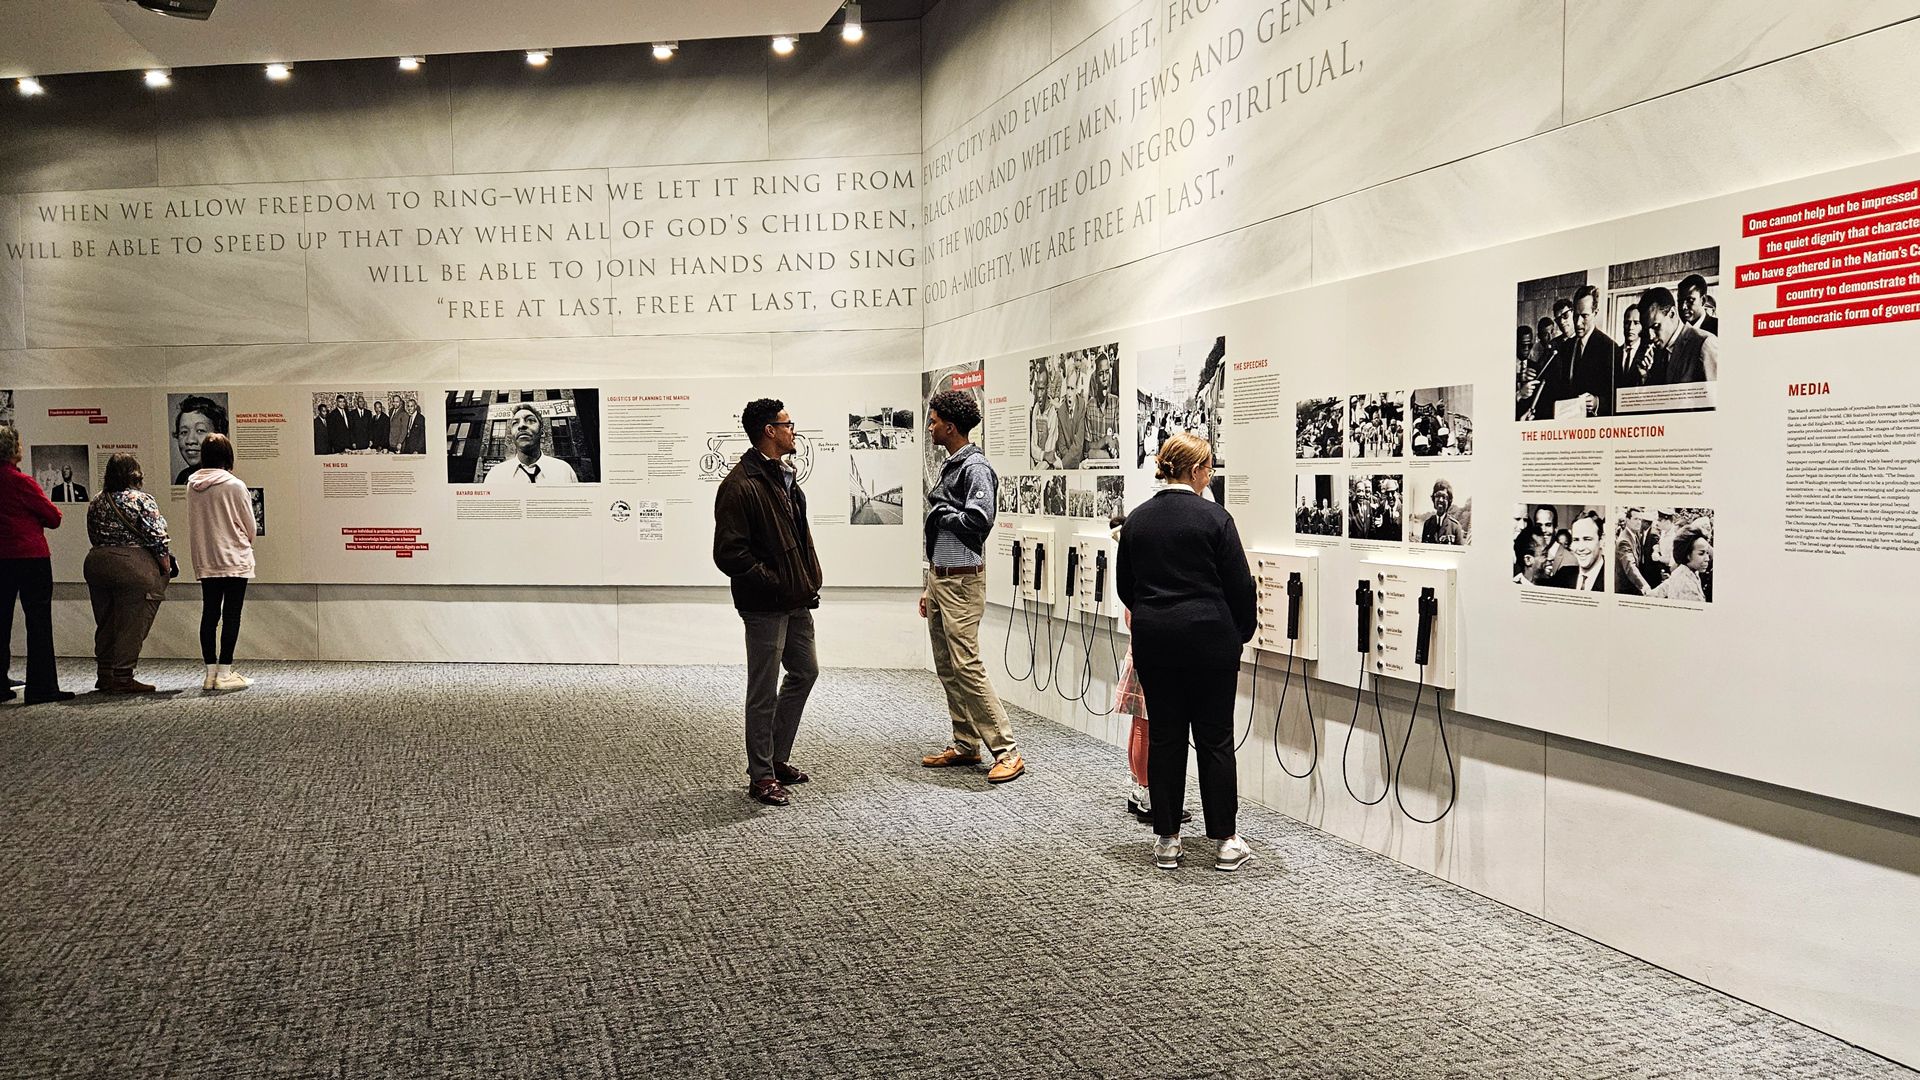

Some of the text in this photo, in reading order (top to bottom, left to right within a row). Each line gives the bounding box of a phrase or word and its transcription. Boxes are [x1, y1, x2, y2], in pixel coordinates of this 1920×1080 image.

[923, 148, 954, 185] EVERY
[958, 129, 986, 164] CITY
[989, 109, 1017, 146] AND
[1024, 73, 1070, 124] EVERY
[1076, 18, 1156, 92] HAMLET,
[924, 191, 955, 226] BLACK
[958, 175, 984, 208] MEN
[988, 158, 1016, 192] AND
[1022, 125, 1070, 172] WHITE
[1078, 99, 1122, 144] MEN,
[1131, 62, 1180, 123] JEWS
[1190, 28, 1244, 82] AND
[924, 39, 1364, 265] IN THE WORDS OF THE OLD NEGRO SPIRITUAL,
[39, 203, 110, 223] WHEN
[120, 201, 154, 220] WE
[165, 198, 248, 219] ALLOW
[259, 192, 376, 215] FREEDOM
[387, 191, 420, 210] TO
[606, 182, 644, 202] WE
[658, 179, 701, 199] LET
[714, 177, 739, 197] IT
[753, 173, 821, 196] RING
[836, 169, 915, 192] FROM
[1749, 188, 1918, 231] One cannot help but be impressed
[7, 209, 916, 260] WILL BE ABLE TO SPEED UP THAT DAY WHEN ALL OF GOD'S CHILDREN,
[924, 279, 947, 305] GOD
[951, 252, 1015, 296] A-MIGHTY,
[1020, 240, 1041, 269] WE
[1047, 226, 1076, 261] ARE
[1083, 207, 1125, 247] FREE
[1132, 194, 1163, 229] AT
[1767, 241, 1782, 253] the
[1784, 237, 1809, 251] quiet
[1811, 230, 1846, 246] dignity
[1848, 225, 1869, 239] that
[368, 248, 915, 283] WILL BE ABLE TO JOIN HANDS AND SING
[1741, 269, 1760, 282] who
[1762, 266, 1785, 279] have
[1786, 258, 1830, 278] gathered
[1832, 256, 1842, 268] in
[1844, 254, 1861, 267] the
[1863, 246, 1908, 264] Nation's
[516, 299, 546, 318] AT
[559, 297, 622, 316] LAST,
[636, 295, 695, 314] FREE
[707, 293, 737, 313] AT
[751, 291, 817, 312] LAST,
[831, 287, 917, 309] GREAT
[1786, 284, 1825, 301] country
[1826, 284, 1837, 295] to
[1838, 275, 1906, 294] demonstrate
[1757, 319, 1767, 330] in
[1769, 318, 1785, 329] our
[1787, 310, 1843, 327] democratic
[1845, 306, 1870, 320] form
[1871, 304, 1884, 317] of
[1234, 359, 1268, 371] THE SPEECHES
[1788, 382, 1830, 396] MEDIA
[1522, 425, 1665, 441] THE HOLLYWOOD CONNECTION
